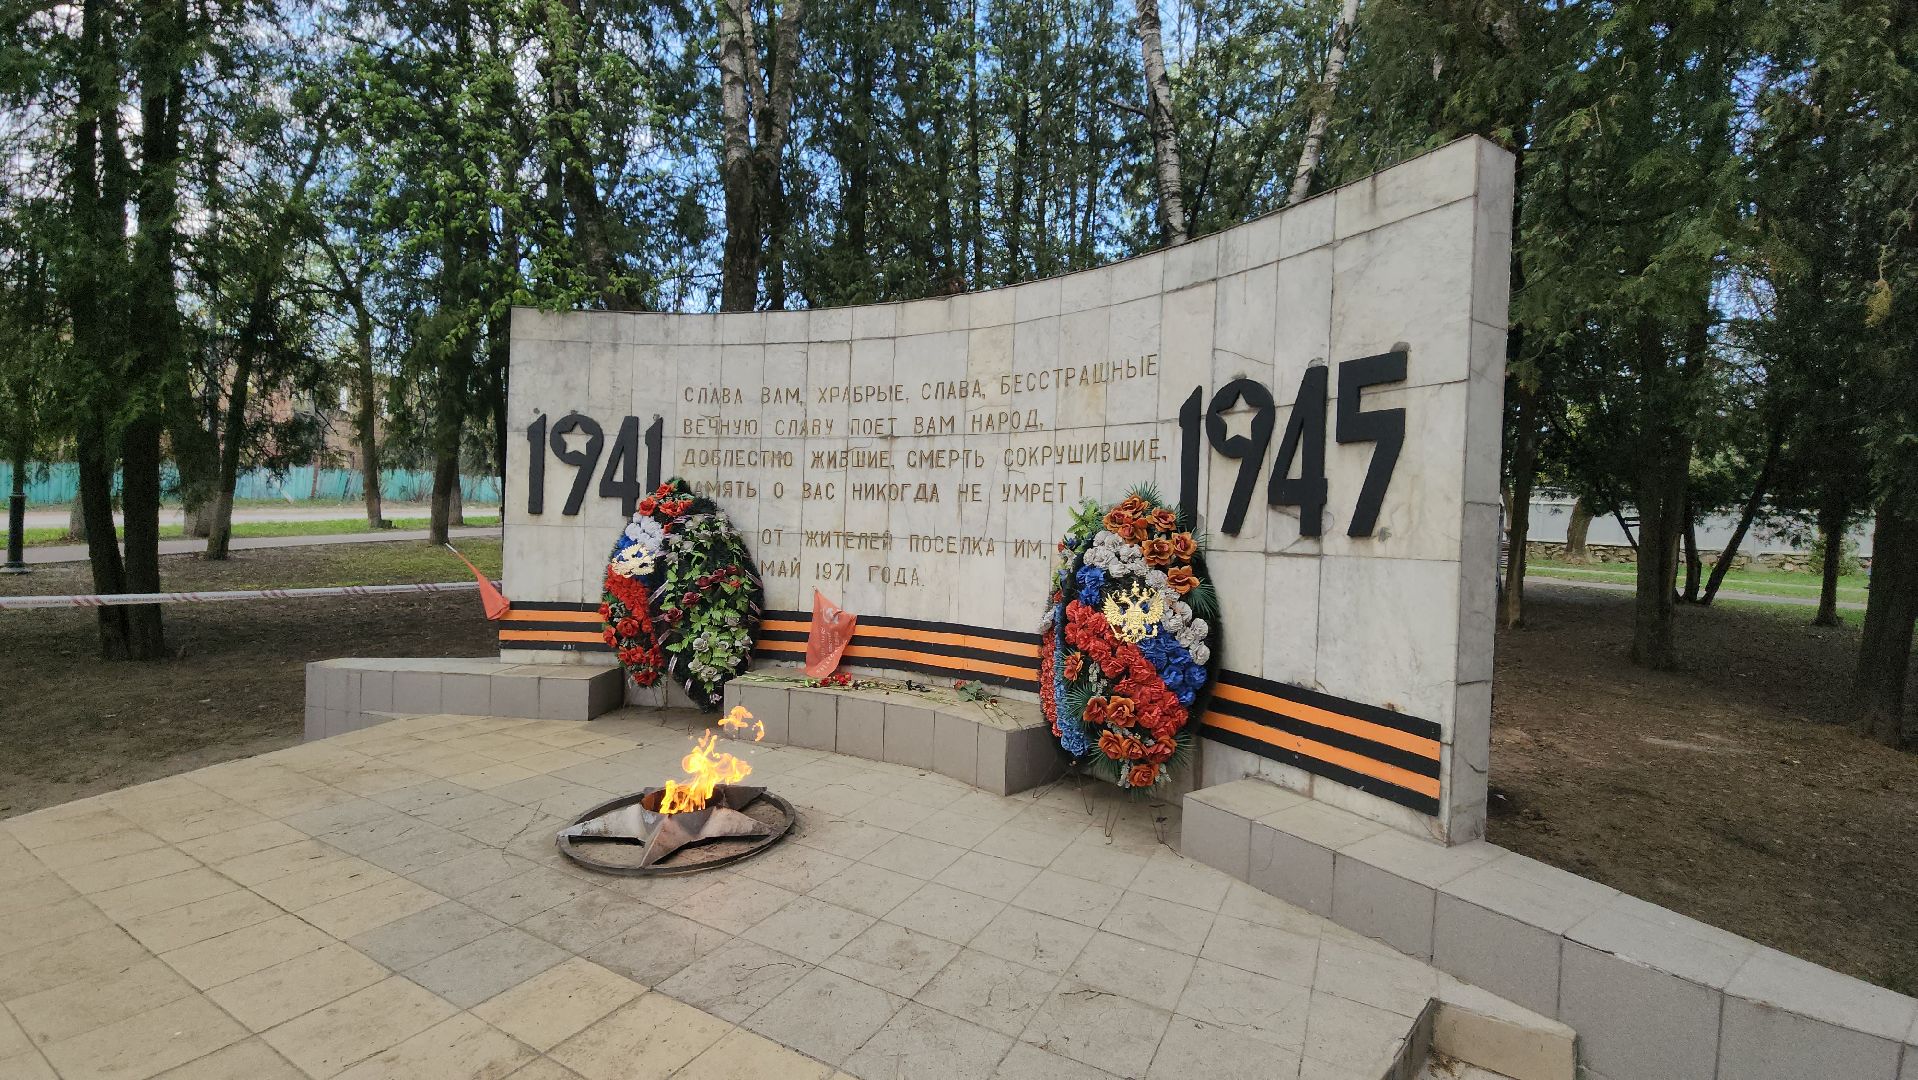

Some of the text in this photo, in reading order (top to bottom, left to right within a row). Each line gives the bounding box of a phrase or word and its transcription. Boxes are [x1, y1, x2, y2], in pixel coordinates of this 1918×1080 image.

[684, 386, 743, 405] СЛАВА
[921, 379, 986, 400] СЛАВА,
[1000, 353, 1158, 396] БЕССТРАШНЫЕ
[683, 418, 758, 436] ВЕЧНУЮ
[775, 418, 834, 436] СЛАВУ
[850, 417, 898, 436] ПОЕТ
[913, 415, 955, 434] ВАМ
[1179, 350, 1408, 538] 1945
[527, 413, 663, 516] 1941
[682, 448, 793, 468] ДОБЛЕСТНО
[906, 449, 985, 469] СМЕРТЬ
[773, 481, 784, 499] О
[802, 482, 835, 500] ВАС
[852, 482, 940, 503] НИКОГДА
[958, 483, 982, 503] НЕ
[761, 528, 783, 547] ОТ
[805, 529, 893, 551] ЖИТЕЛЕЙ
[909, 534, 996, 556] ПОСЕЛКА
[760, 556, 801, 579] МАЙ
[815, 562, 850, 583] 1971
